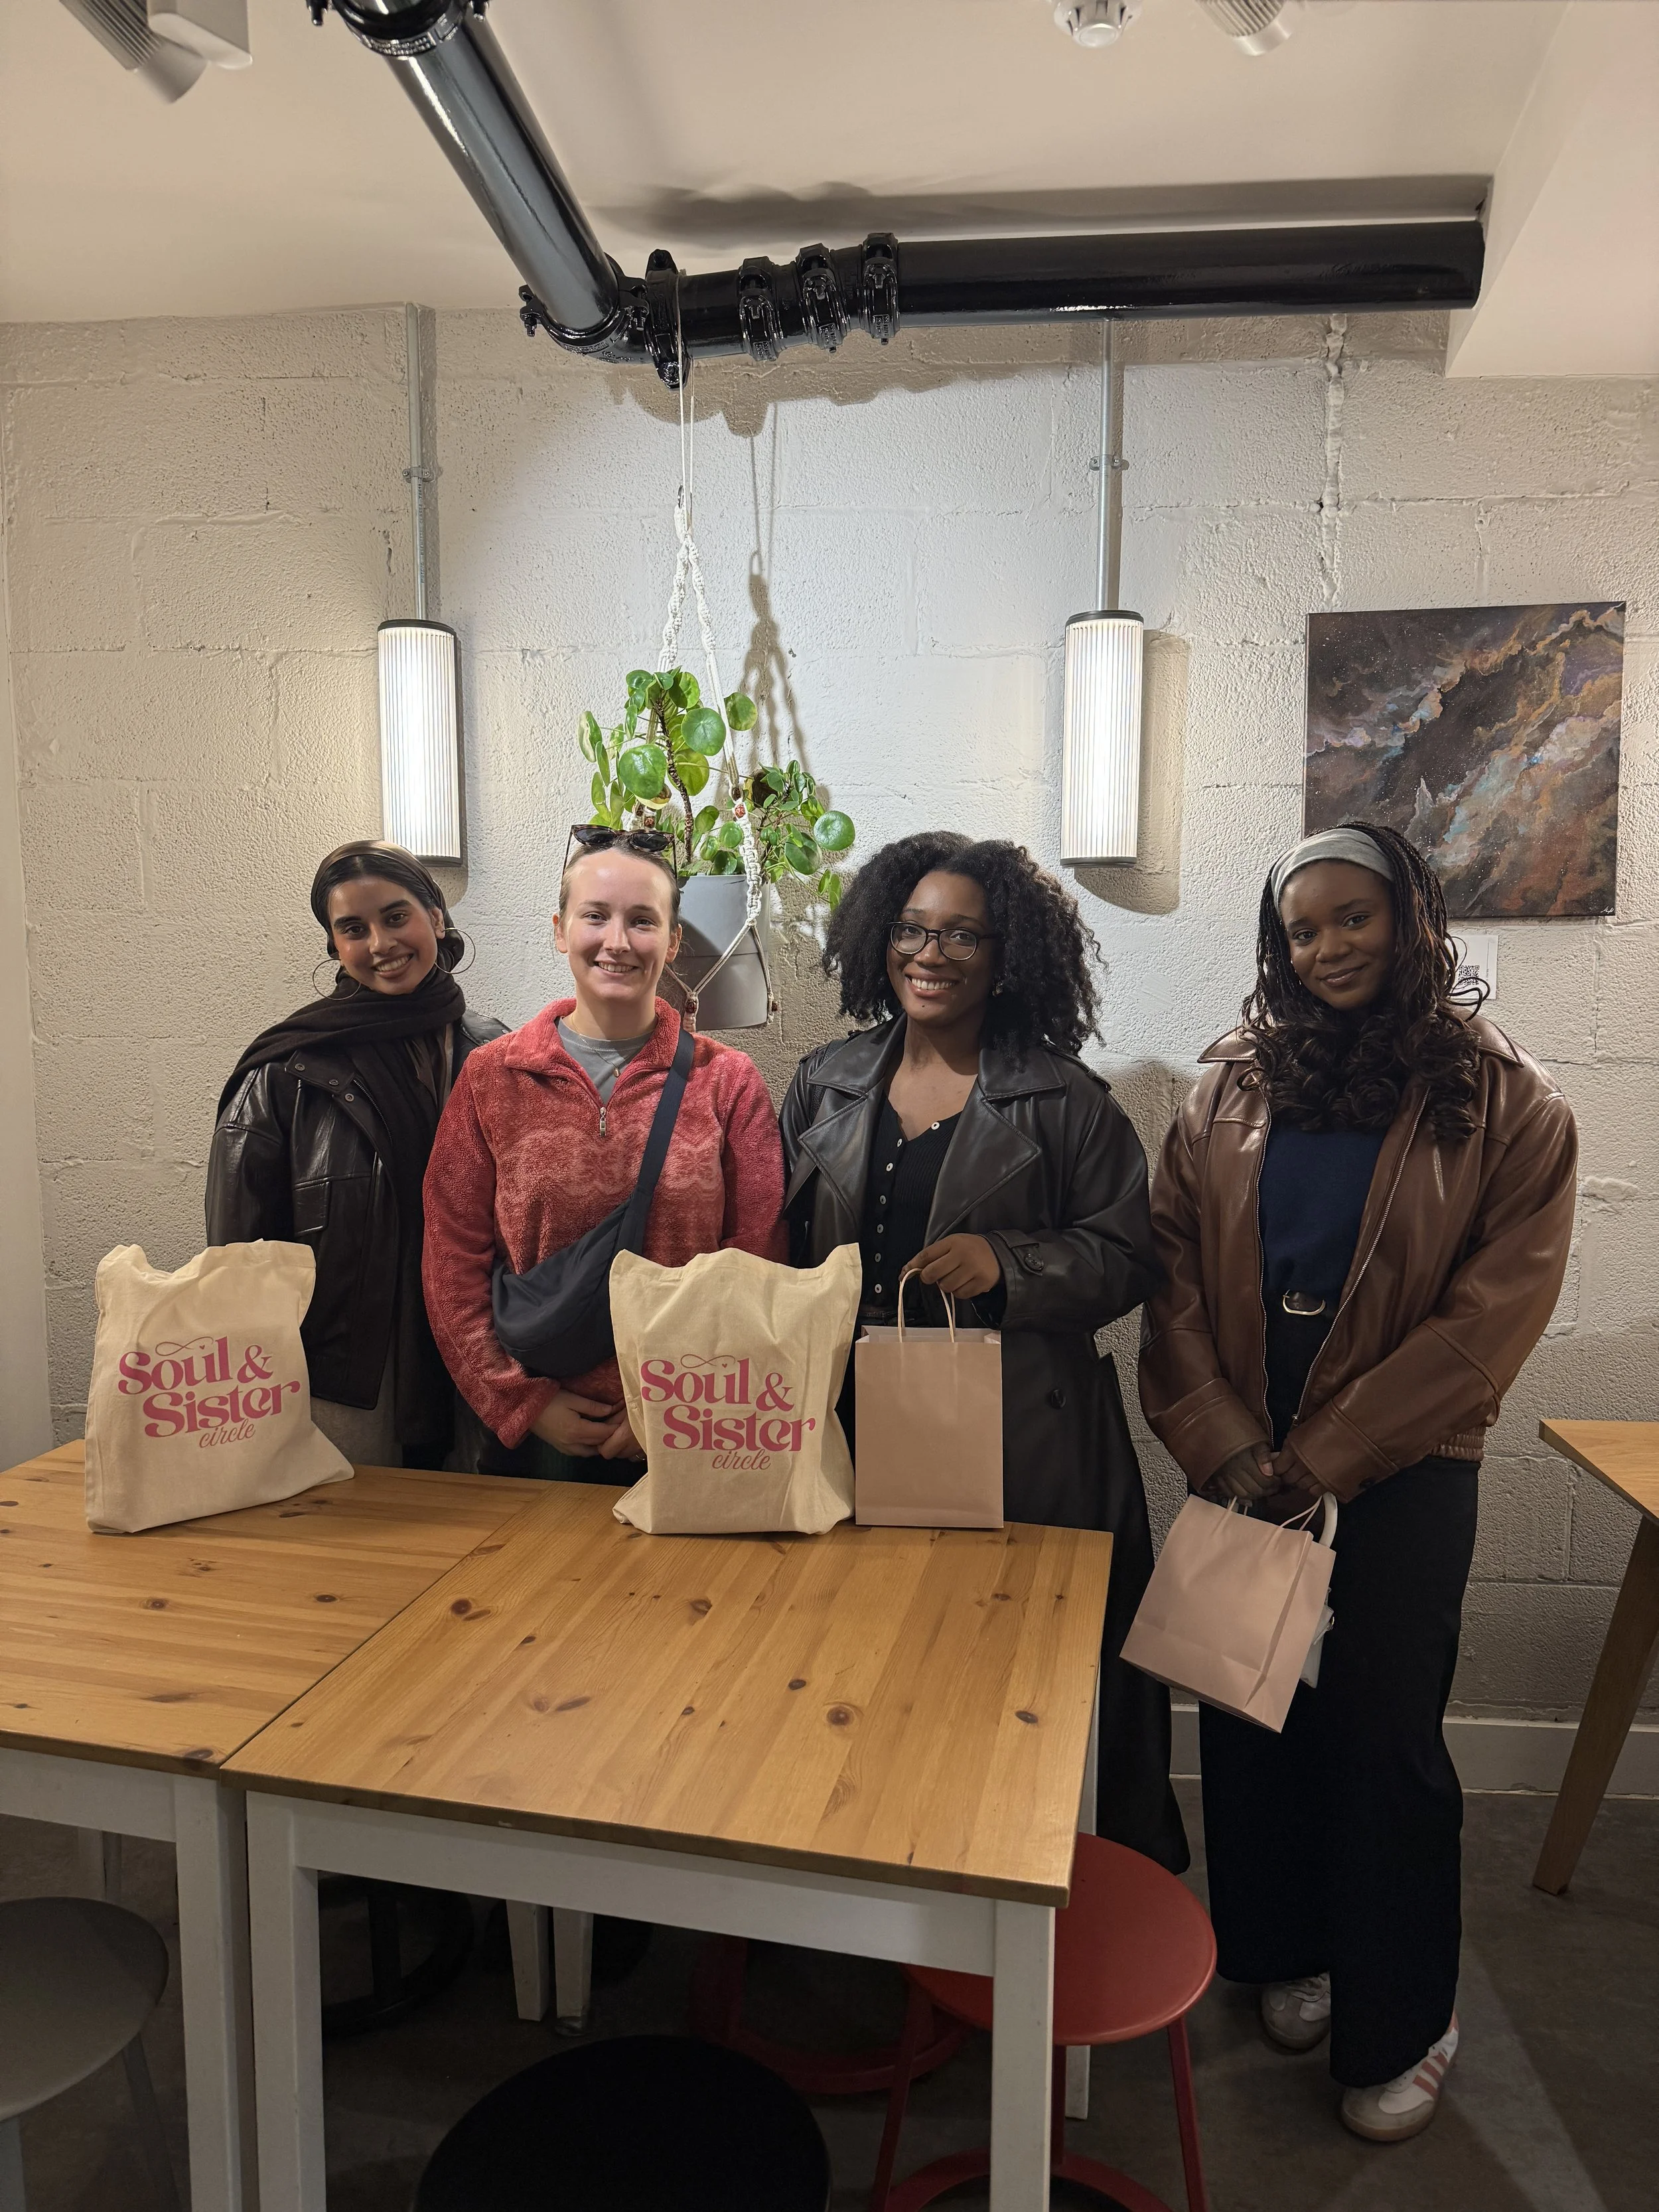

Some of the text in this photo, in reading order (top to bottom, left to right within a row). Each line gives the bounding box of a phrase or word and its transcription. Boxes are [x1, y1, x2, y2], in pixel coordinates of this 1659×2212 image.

[117, 1336, 273, 1395] Soul &
[640, 1357, 795, 1412] Soul &
[142, 1380, 301, 1438] Sister
[199, 1418, 256, 1448] circle
[662, 1404, 816, 1452] Sister
[711, 1448, 772, 1471] circle
